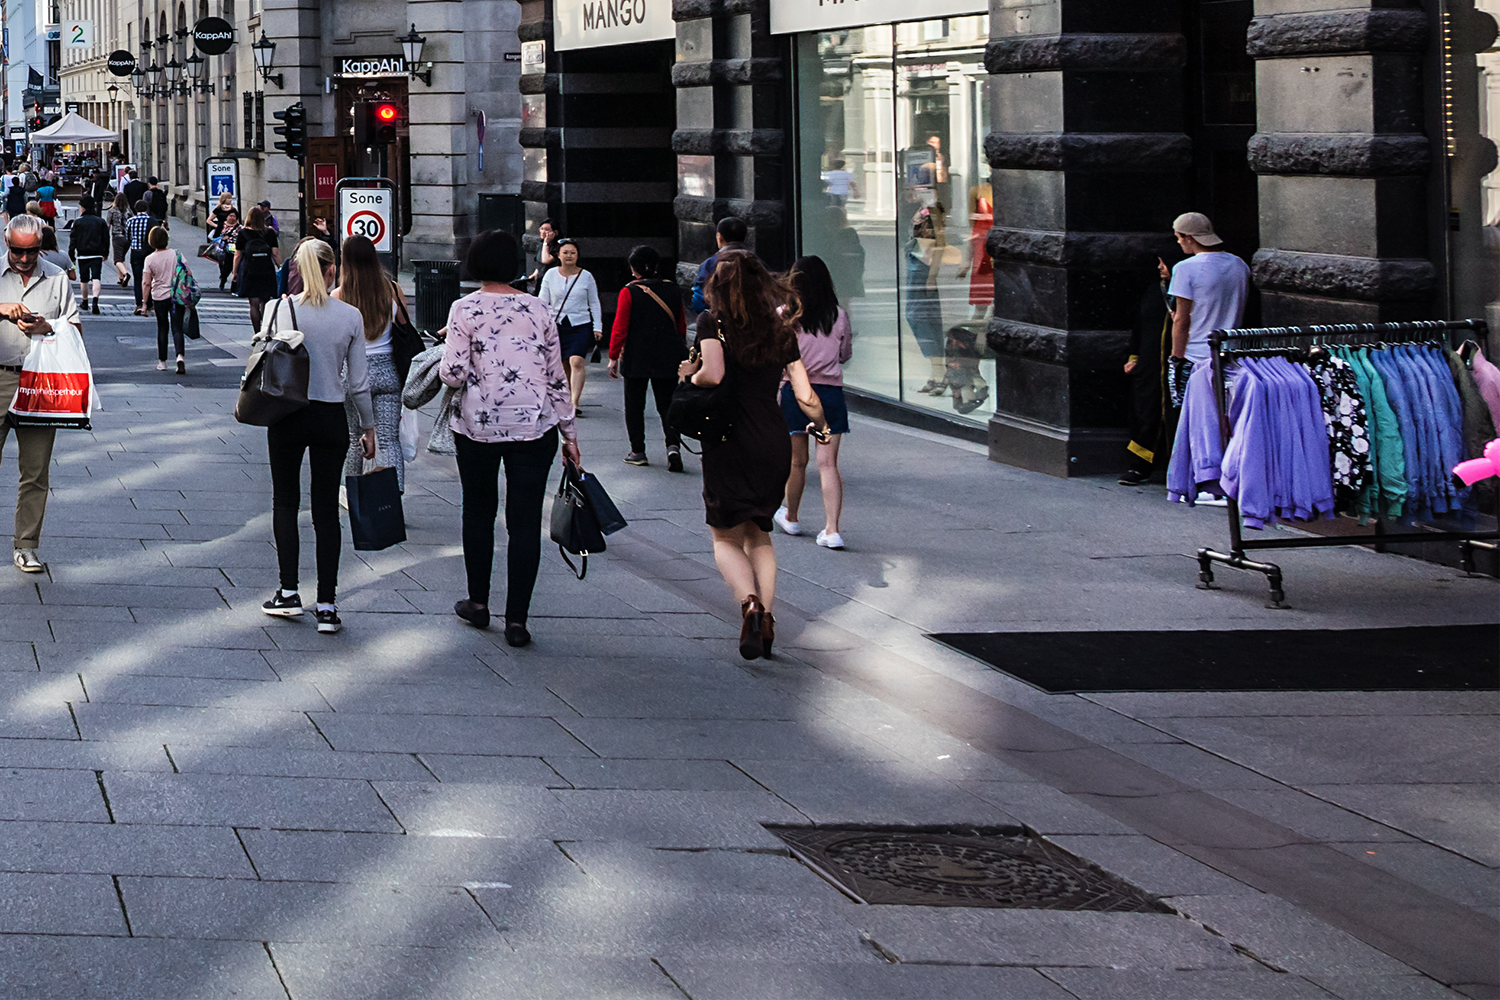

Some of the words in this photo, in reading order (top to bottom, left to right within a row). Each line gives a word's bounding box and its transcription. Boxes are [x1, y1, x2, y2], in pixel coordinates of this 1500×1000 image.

[71, 25, 85, 44] 2
[195, 31, 232, 40] KappAhl
[108, 59, 134, 67] KappAhl
[342, 59, 404, 75] KappAhl
[212, 164, 231, 172] Sone
[318, 177, 334, 185] SALE
[350, 192, 382, 204] Sone
[354, 219, 379, 237] 30
